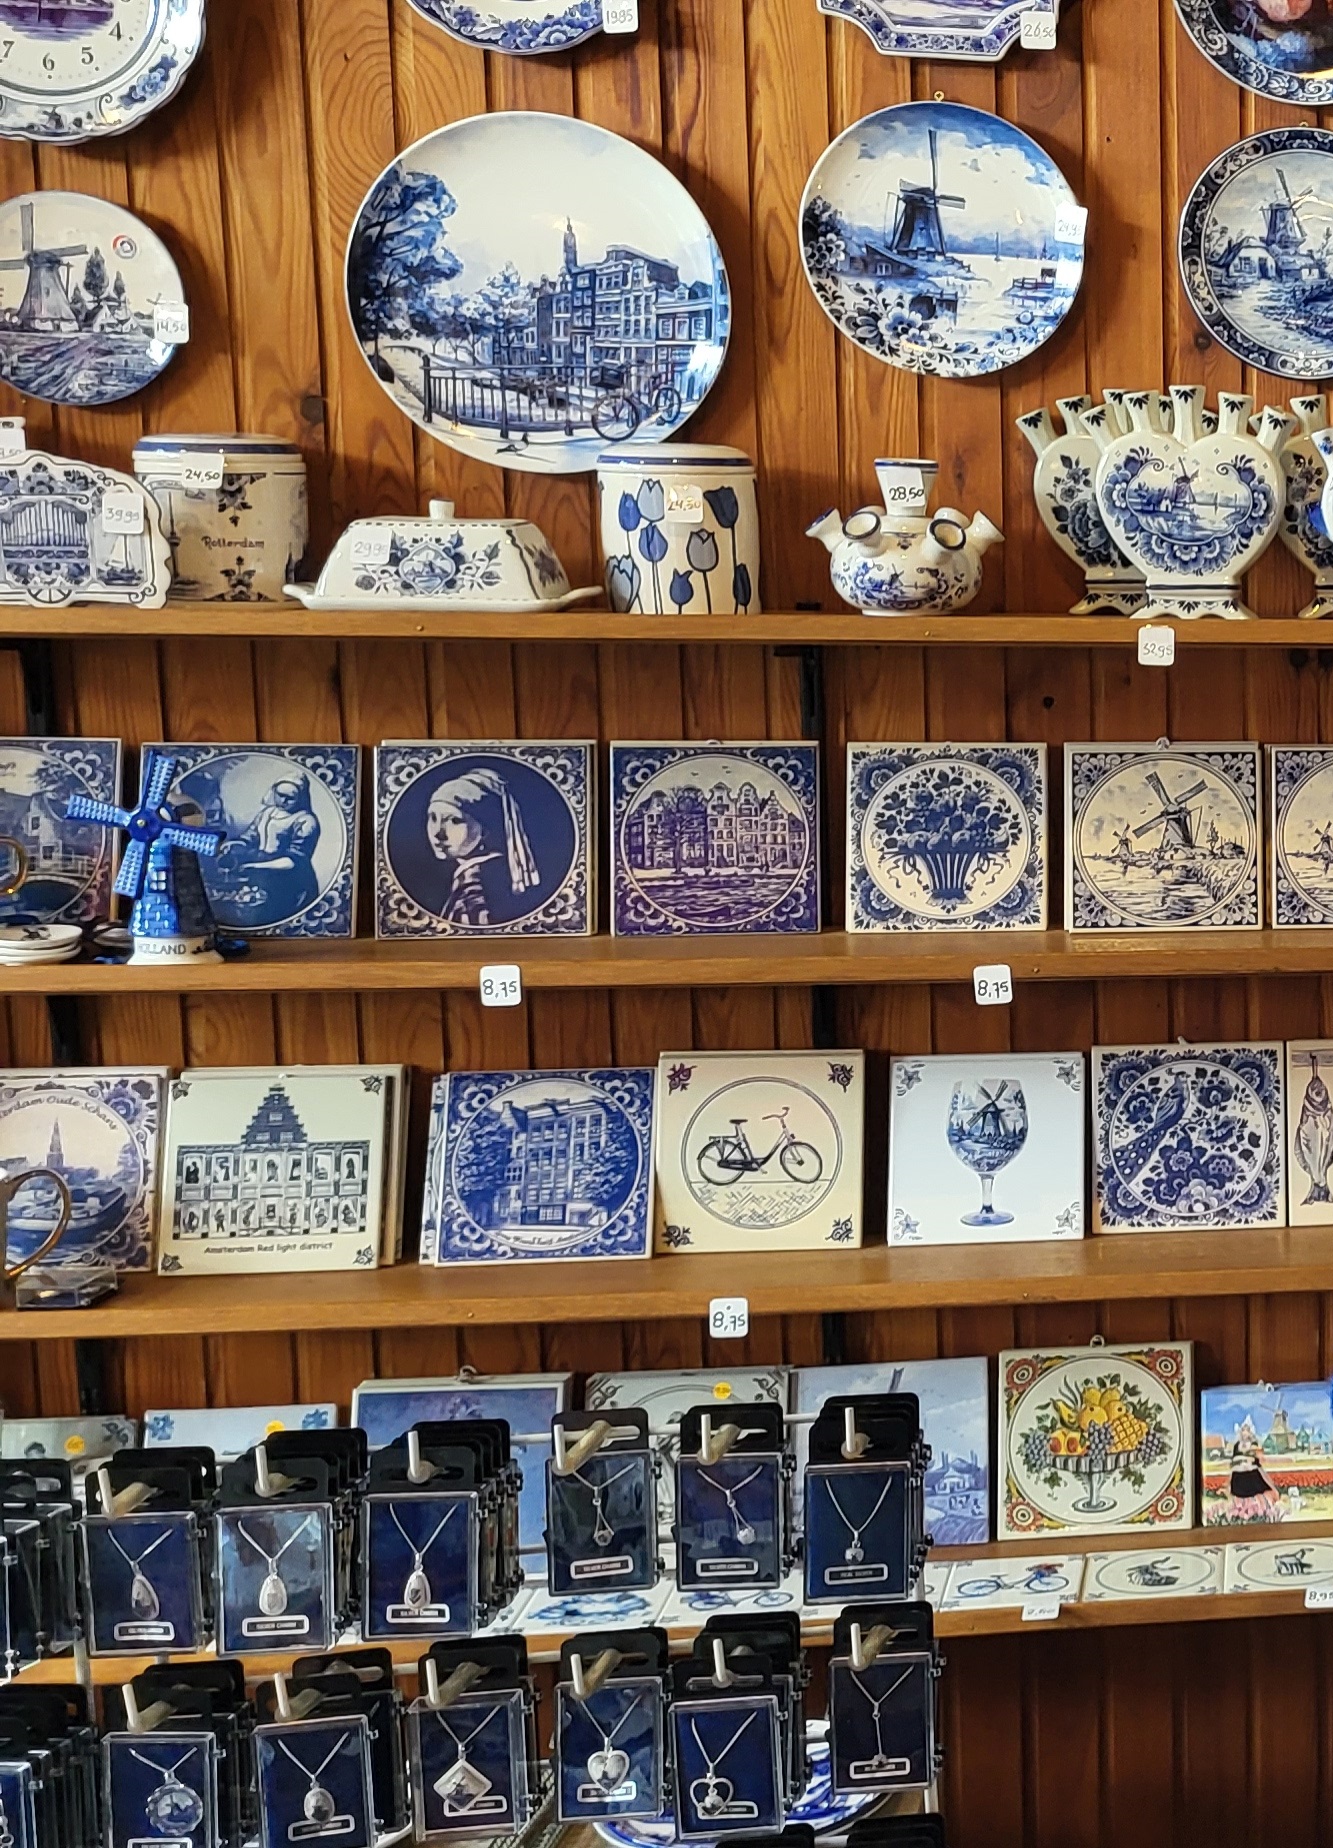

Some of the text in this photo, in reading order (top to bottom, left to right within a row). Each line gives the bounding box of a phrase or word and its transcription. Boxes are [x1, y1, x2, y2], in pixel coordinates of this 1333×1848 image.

[108, 20, 123, 41] 4
[2, 39, 15, 58] 7
[81, 46, 95, 65] 5
[42, 52, 55, 71] 6
[185, 470, 220, 483] 24,50
[889, 487, 924, 502] 28,50
[202, 535, 265, 549] Rotterdam
[0, 1097, 43, 1118] erdam
[47, 1095, 80, 1107] Oude
[204, 1244, 254, 1254] Amsterdam
[257, 1243, 274, 1253] Red
